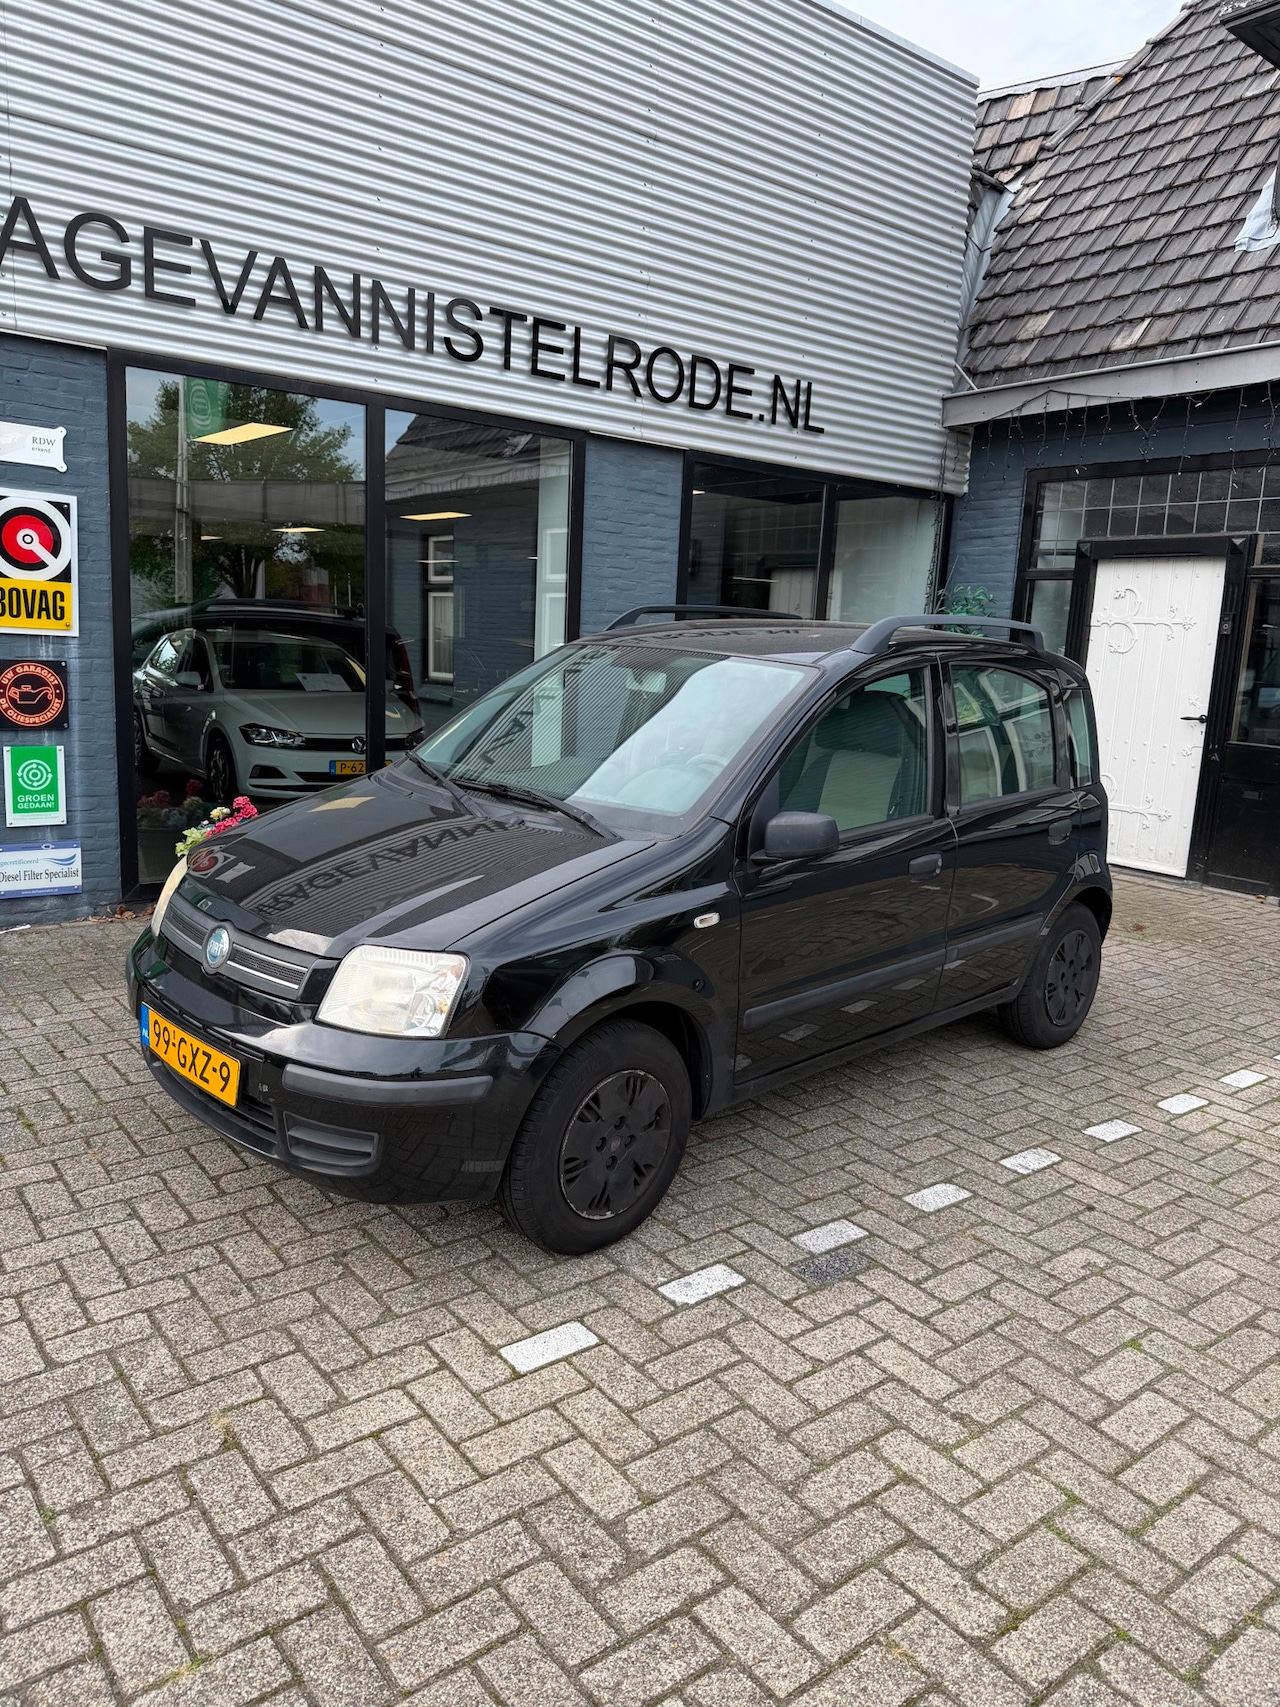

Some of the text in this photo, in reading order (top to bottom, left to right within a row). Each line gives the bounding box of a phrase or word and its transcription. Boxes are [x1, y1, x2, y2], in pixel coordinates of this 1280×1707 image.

[0, 196, 825, 434] AGEVANNISTELRODE.NL
[32, 436, 56, 446] RDW
[1, 665, 59, 685] UW GARAGIST
[0, 698, 62, 723] DE OLIESPECIALIST
[340, 762, 364, 773] P-62
[17, 793, 55, 803] GROEN
[0, 867, 79, 883] Diesel Filter Specialist
[153, 1020, 231, 1093] 99-GXZ-9
